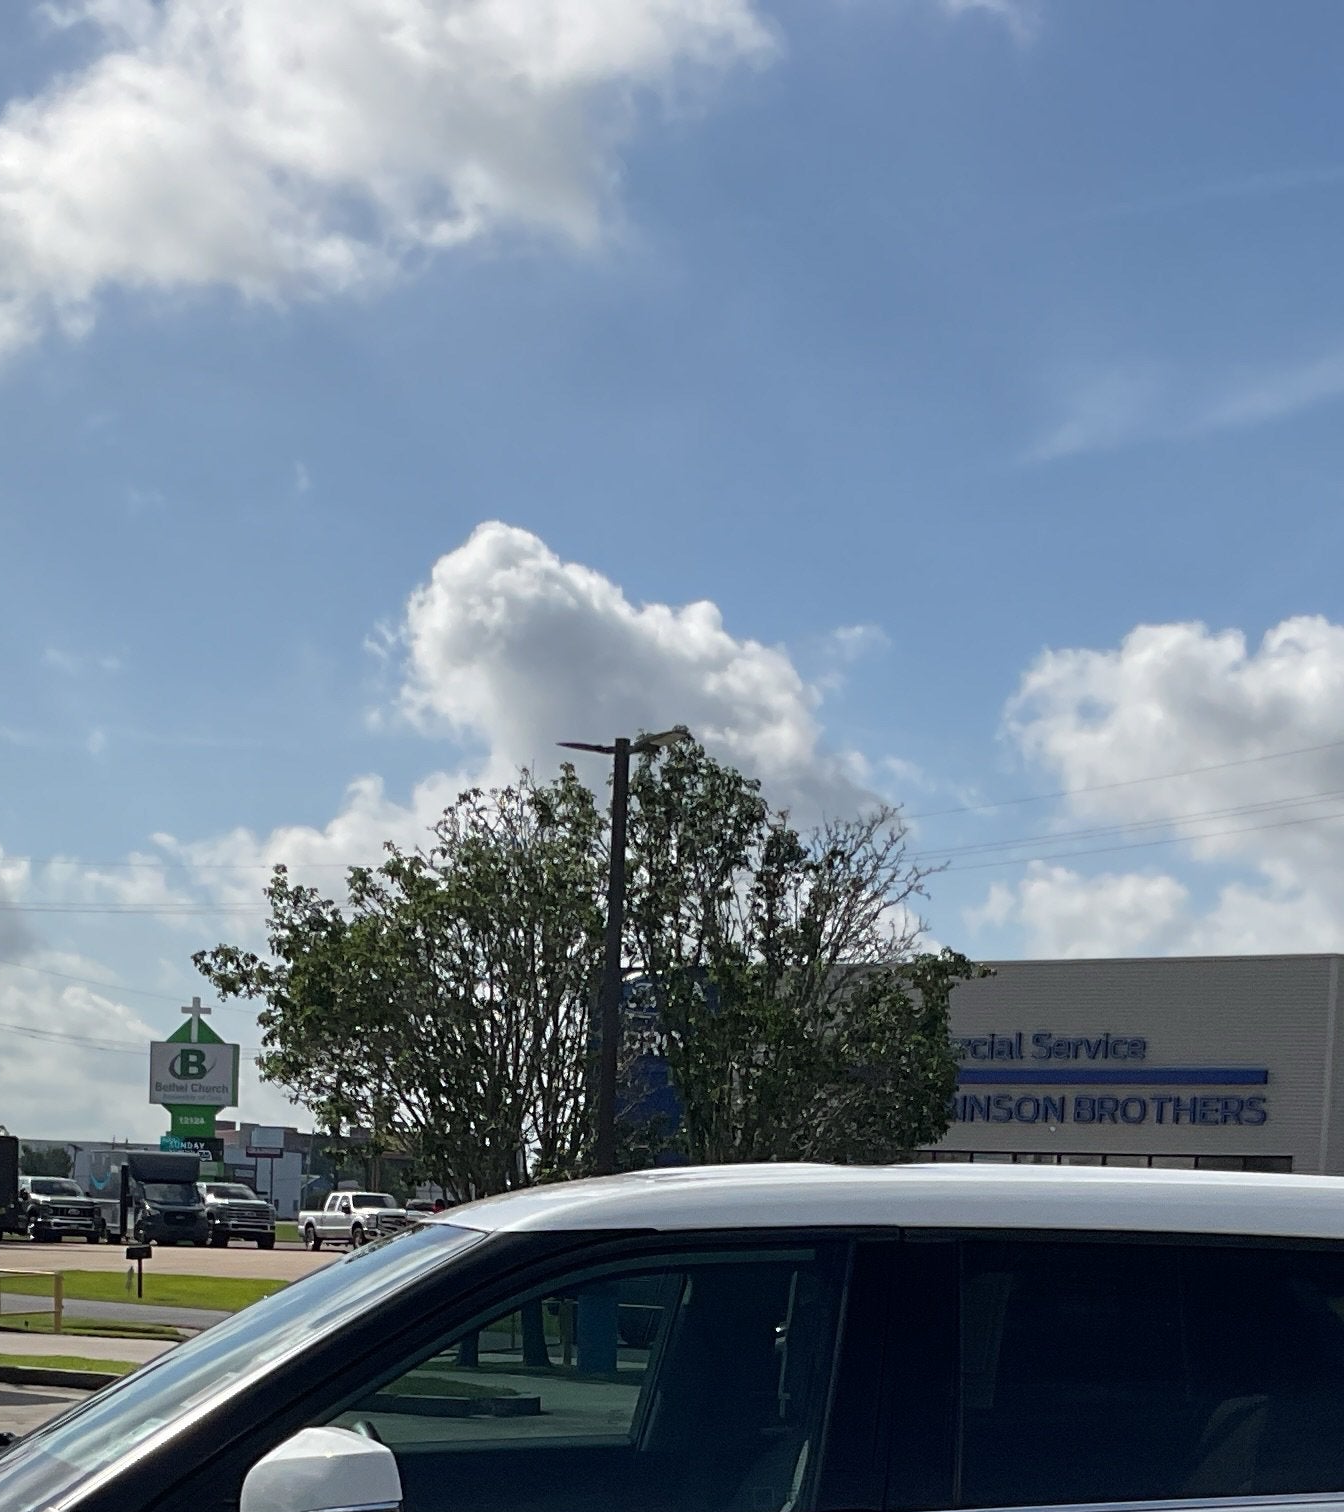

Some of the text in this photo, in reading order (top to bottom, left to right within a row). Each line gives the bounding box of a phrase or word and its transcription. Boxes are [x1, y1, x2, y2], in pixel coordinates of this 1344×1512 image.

[952, 1031, 1147, 1060] rcial Service
[155, 1081, 229, 1094] Bethel Church
[1072, 1093, 1268, 1126] BROTHERS
